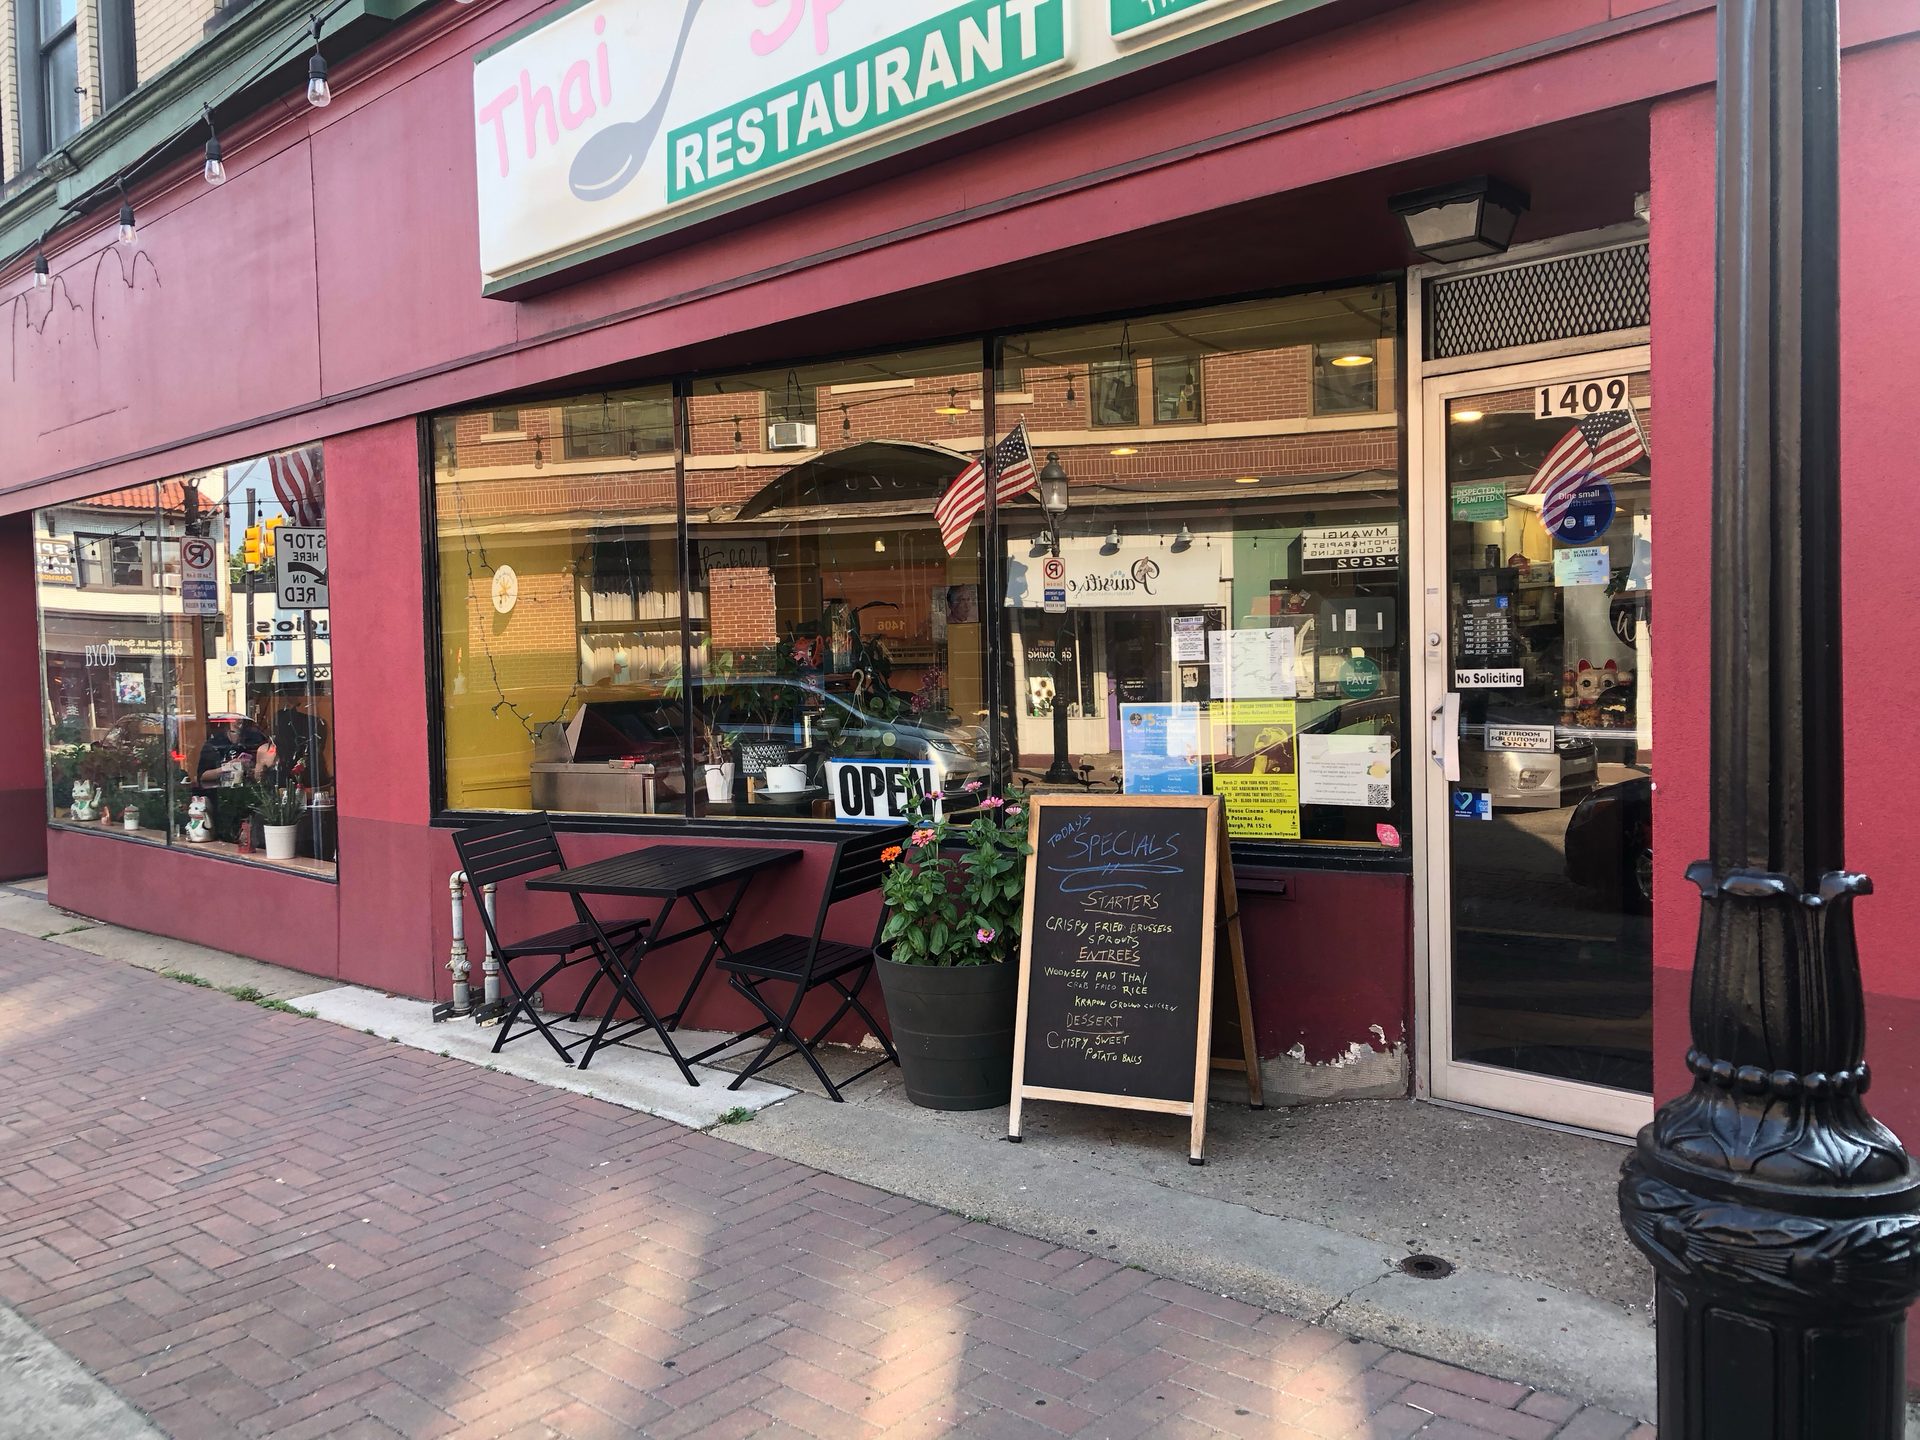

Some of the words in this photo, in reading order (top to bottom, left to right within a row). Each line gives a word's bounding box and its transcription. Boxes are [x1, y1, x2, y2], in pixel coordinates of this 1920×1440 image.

[478, 14, 613, 178] Thai
[675, 0, 1047, 190] RESTAURANT
[1541, 379, 1625, 416] 1409
[1456, 487, 1495, 497] INSPECTED
[1456, 494, 1495, 504] PERMITTED
[1578, 490, 1600, 498] small
[85, 644, 117, 667] BYOB
[1346, 676, 1372, 685] FAVE
[1457, 673, 1471, 684] No
[1473, 672, 1522, 686] Soliciting
[838, 764, 935, 817] OPEN
[1067, 831, 1180, 862] SPECIALS
[1080, 891, 1160, 911] STARTERS
[1046, 916, 1088, 936] CRISPY
[1094, 922, 1123, 933] FRIED
[1130, 923, 1172, 934] BRUSSELS
[1088, 934, 1140, 948] SPROUTS
[1079, 946, 1141, 962] ENTREES
[1096, 971, 1116, 980] PAD
[1121, 972, 1148, 984] THAI
[1122, 986, 1148, 996] RICE
[1109, 1000, 1141, 1009] GROUND
[1144, 1002, 1178, 1012] CHICKEN
[1066, 1012, 1123, 1028] DESSERT
[1095, 1035, 1130, 1045] SWEET
[1122, 1054, 1142, 1065] BALLS
